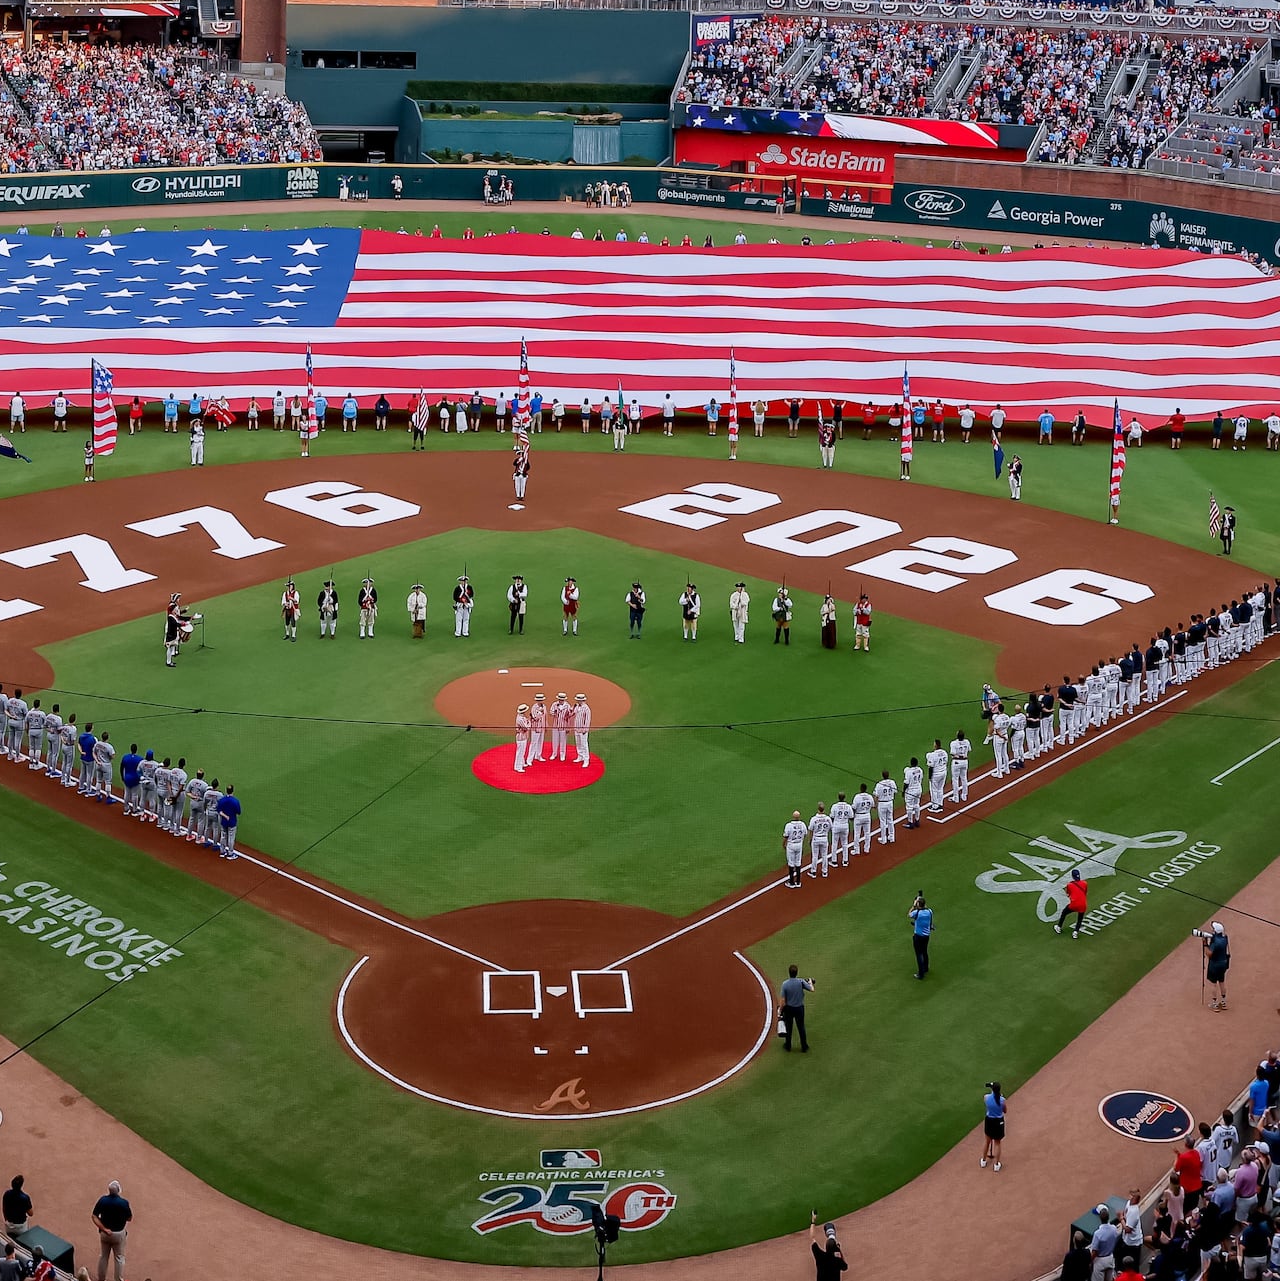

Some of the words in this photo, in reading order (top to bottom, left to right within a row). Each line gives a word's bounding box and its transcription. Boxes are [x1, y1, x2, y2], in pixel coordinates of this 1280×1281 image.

[697, 22, 730, 31] BRAVES
[697, 30, 730, 40] VISION
[288, 168, 318, 180] PAPA
[164, 174, 240, 190] HYUNDAI
[286, 179, 319, 190] JOHNS
[164, 190, 224, 198] HyundaiUSA.com
[838, 202, 874, 215] National
[914, 192, 954, 212] Ford
[1010, 207, 1061, 226] Georgia
[1064, 212, 1104, 227] Power
[1180, 223, 1207, 236] KAISER
[618, 482, 1154, 626] 2026
[974, 820, 1188, 923] SAIA
[1070, 890, 1143, 936] FREIGHT
[1141, 840, 1222, 888] LOGISTICS
[13, 880, 185, 967] CHEROKEE
[478, 1170, 580, 1182] CELEBRATING
[584, 1169, 666, 1180] AMERICA'S
